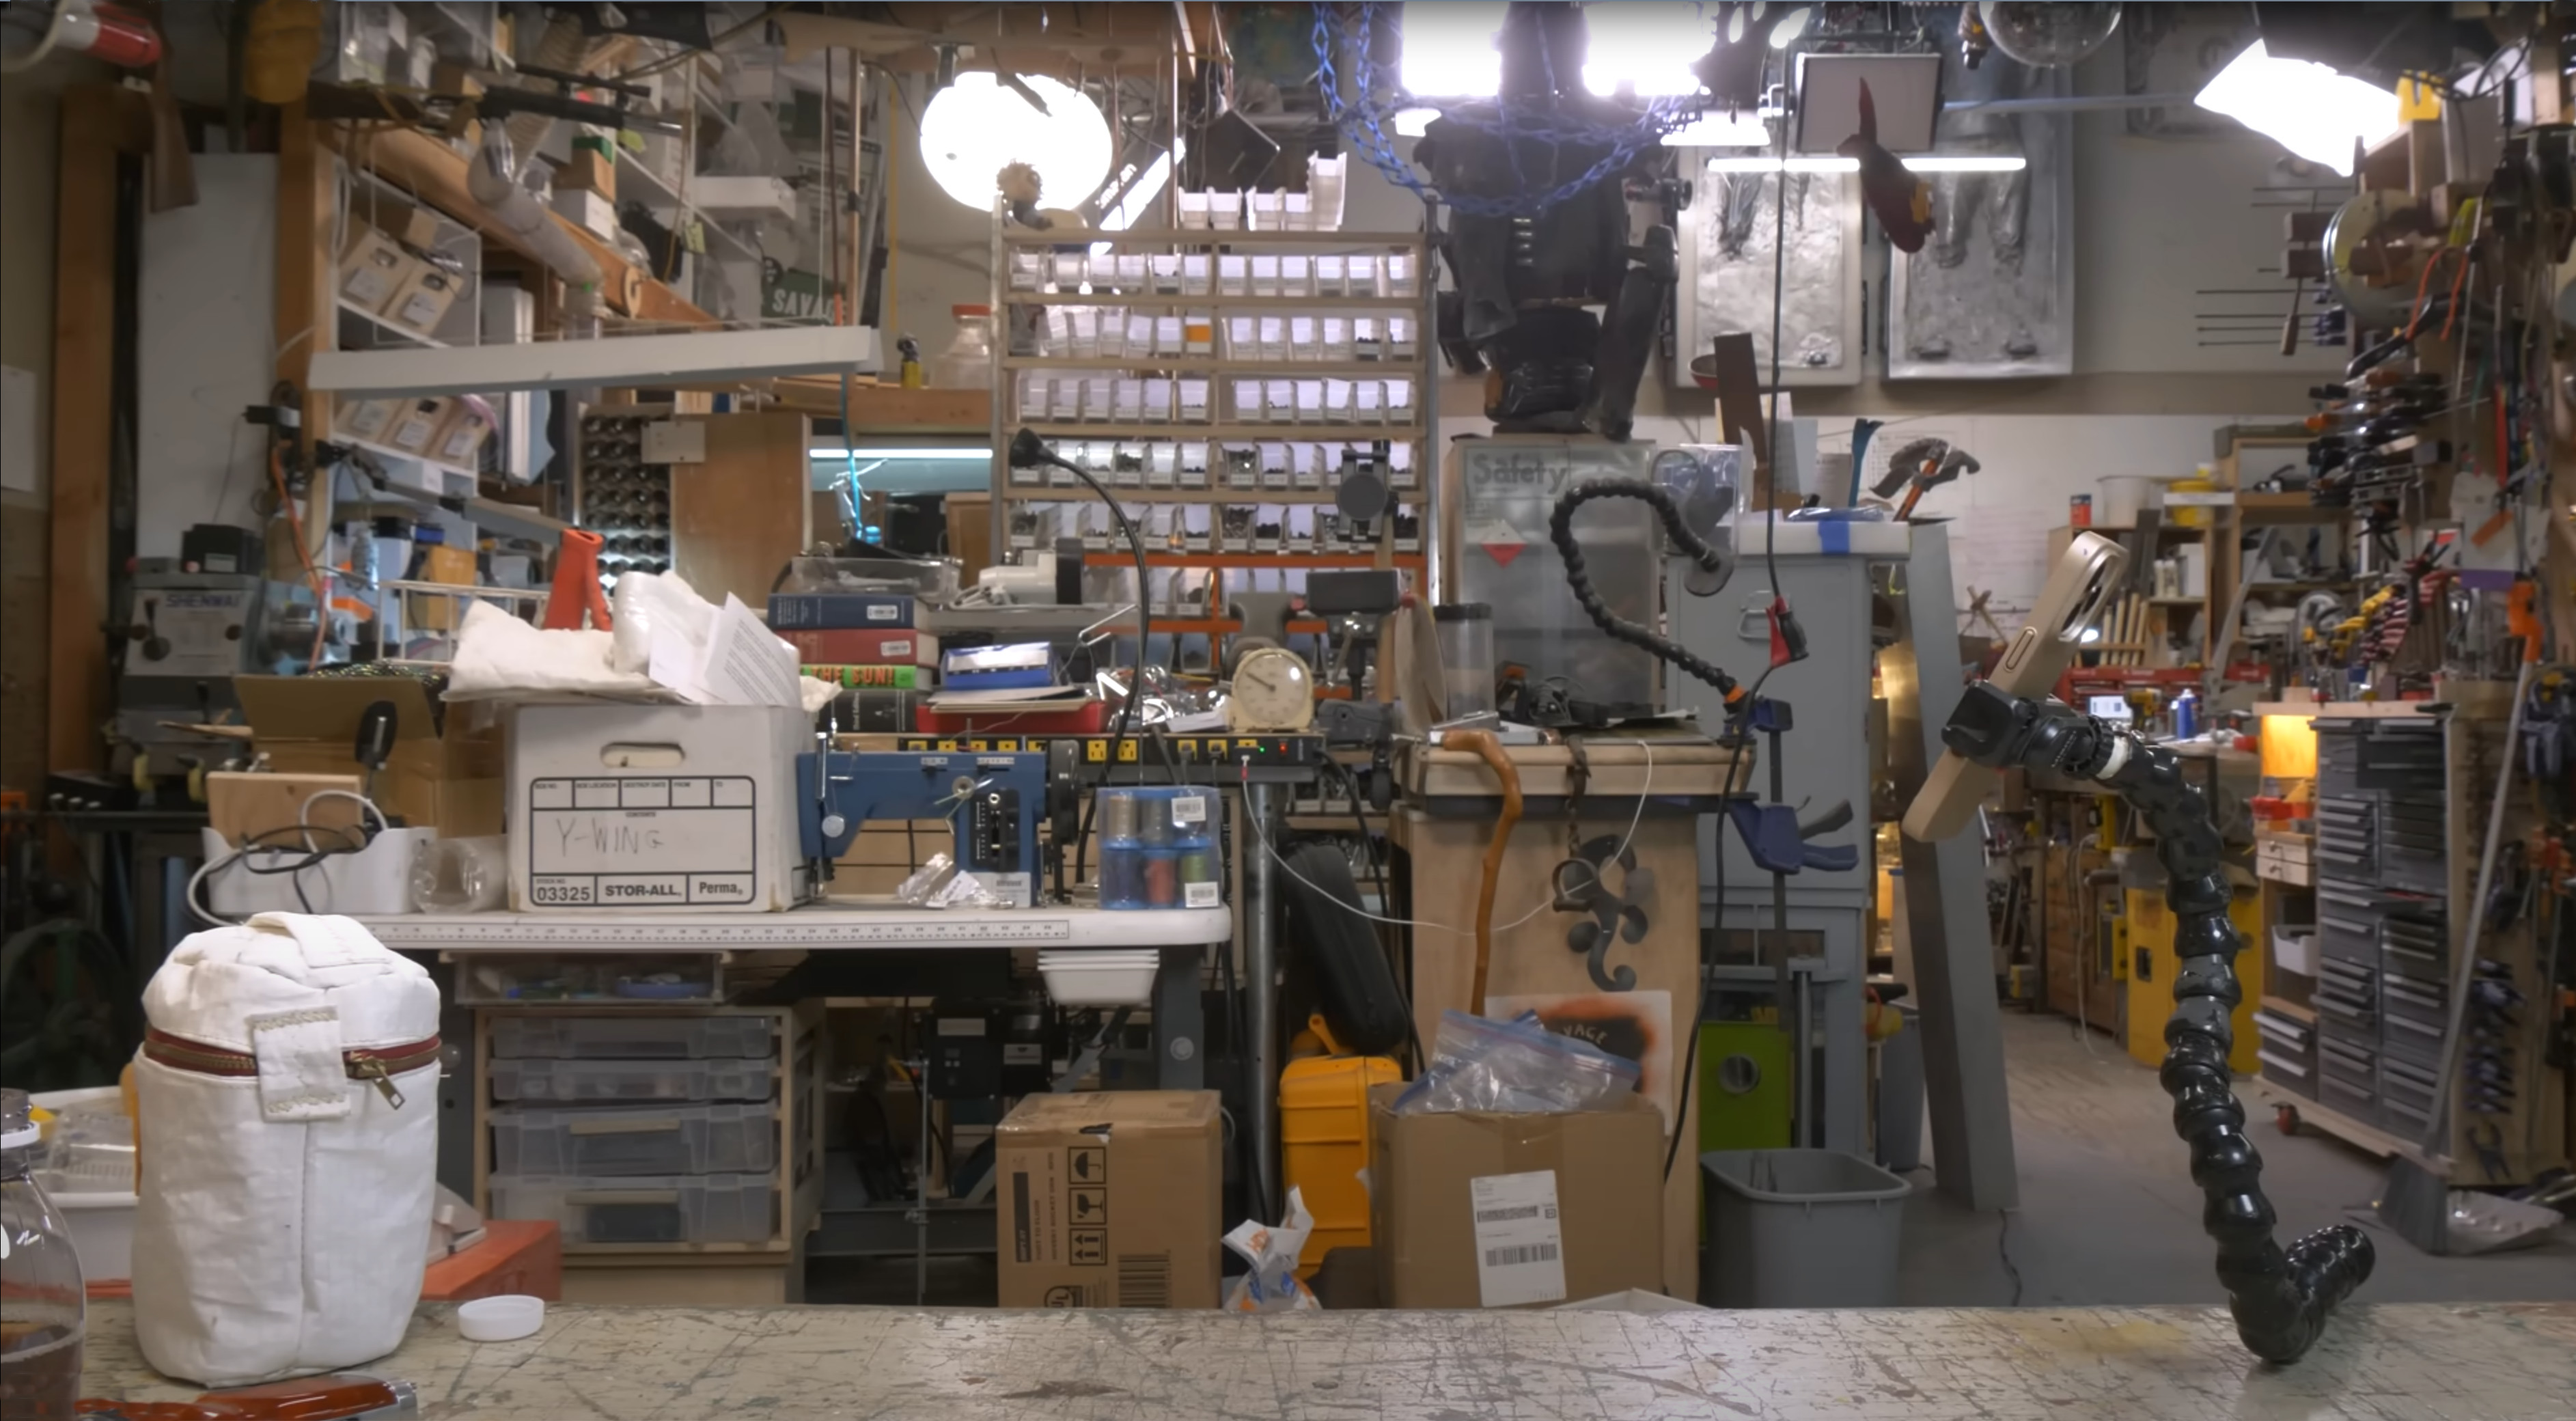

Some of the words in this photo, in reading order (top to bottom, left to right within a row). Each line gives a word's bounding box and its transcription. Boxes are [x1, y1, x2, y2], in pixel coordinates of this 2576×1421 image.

[1473, 452, 1567, 495] Safety
[810, 666, 843, 682] THE
[852, 665, 895, 685] SUN!
[555, 817, 665, 857] Y-WING
[536, 886, 591, 902] 03325
[605, 885, 678, 897] STOR-ALL
[699, 881, 738, 894] Perma
